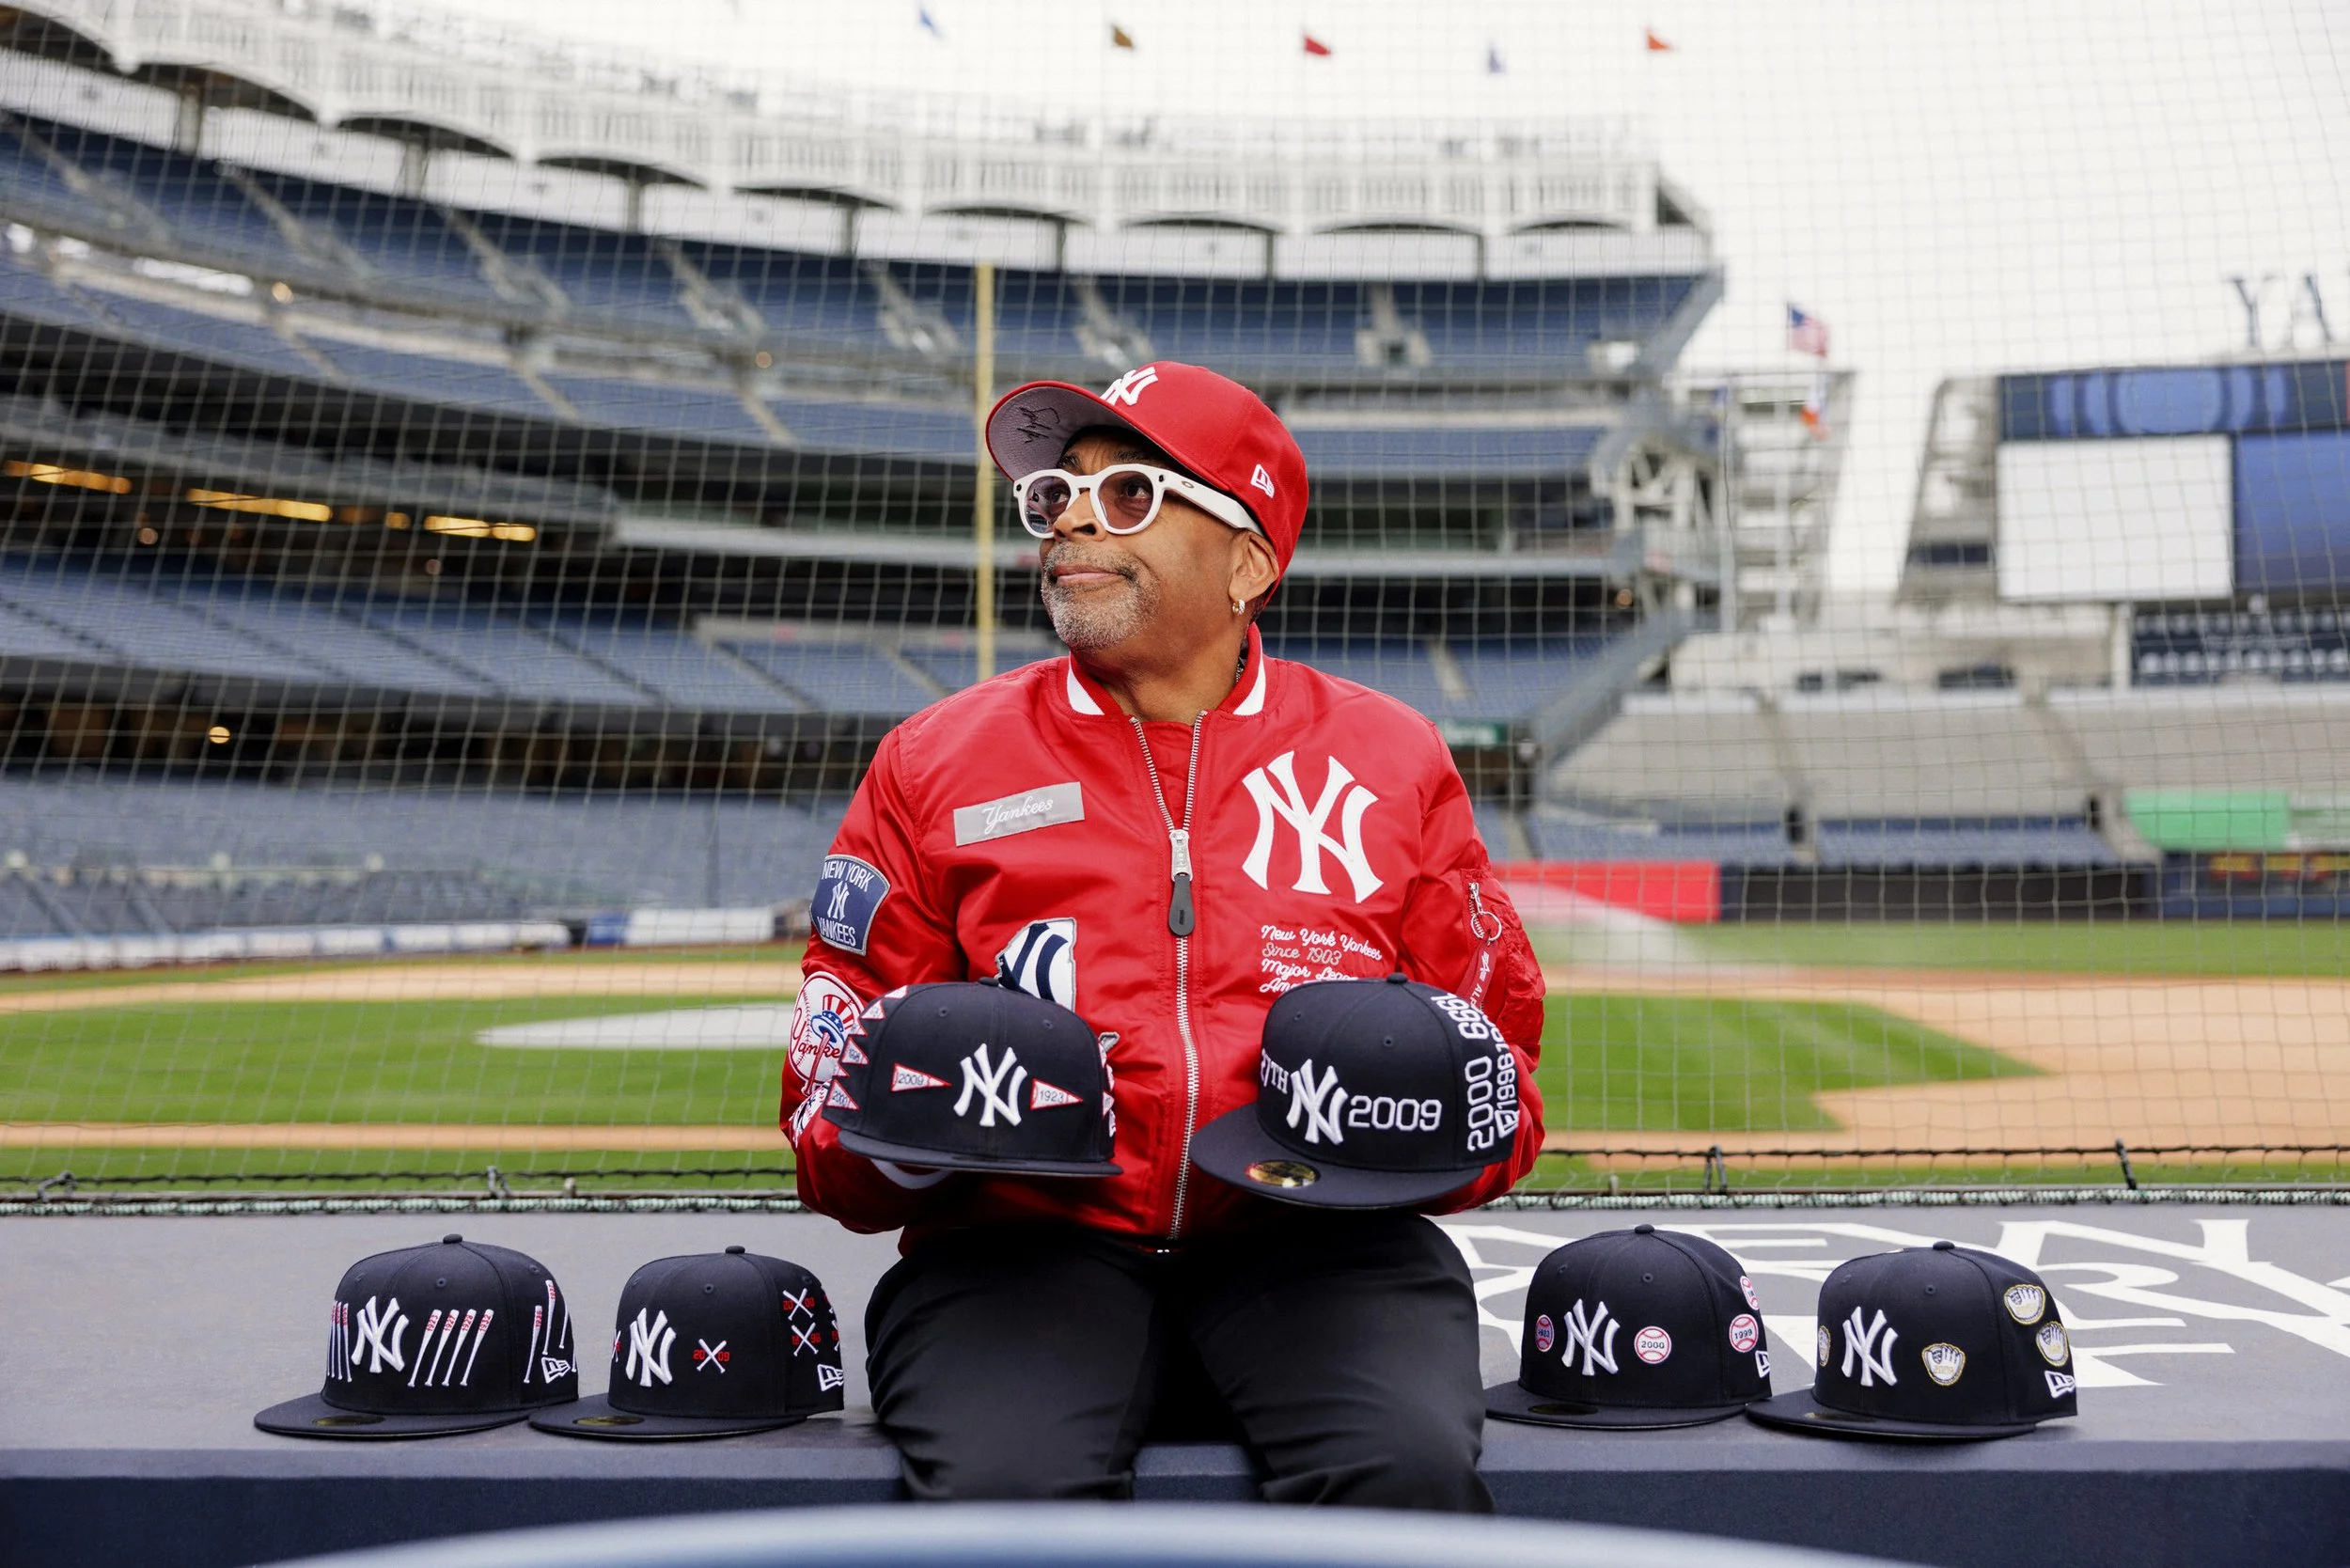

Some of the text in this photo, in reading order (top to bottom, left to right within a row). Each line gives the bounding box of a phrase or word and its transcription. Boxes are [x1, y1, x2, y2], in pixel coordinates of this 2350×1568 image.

[2227, 271, 2350, 348] YA
[981, 795, 1054, 835] Yankees
[1242, 750, 1385, 904] NY
[822, 860, 875, 892] NEW YORK
[827, 880, 850, 921] NY
[817, 917, 856, 947] YANKEES
[1261, 925, 1383, 961] New York Yankees
[1261, 942, 1342, 965] Since 1903
[1261, 958, 1311, 980] Major
[1431, 993, 1490, 1040] 1999
[898, 1074, 925, 1087] 2009
[953, 1043, 1027, 1127] NY
[1039, 1090, 1064, 1104] 1923
[1286, 1058, 1348, 1145] NY
[1348, 1095, 1443, 1132] 2009
[1465, 1056, 1495, 1152] 2000
[352, 1295, 409, 1373] NY
[426, 1314, 439, 1331] 1923
[1561, 1298, 1621, 1376] NY
[625, 1308, 677, 1388] NY
[1641, 1341, 1665, 1349] 2000
[1841, 1306, 1899, 1387] NY
